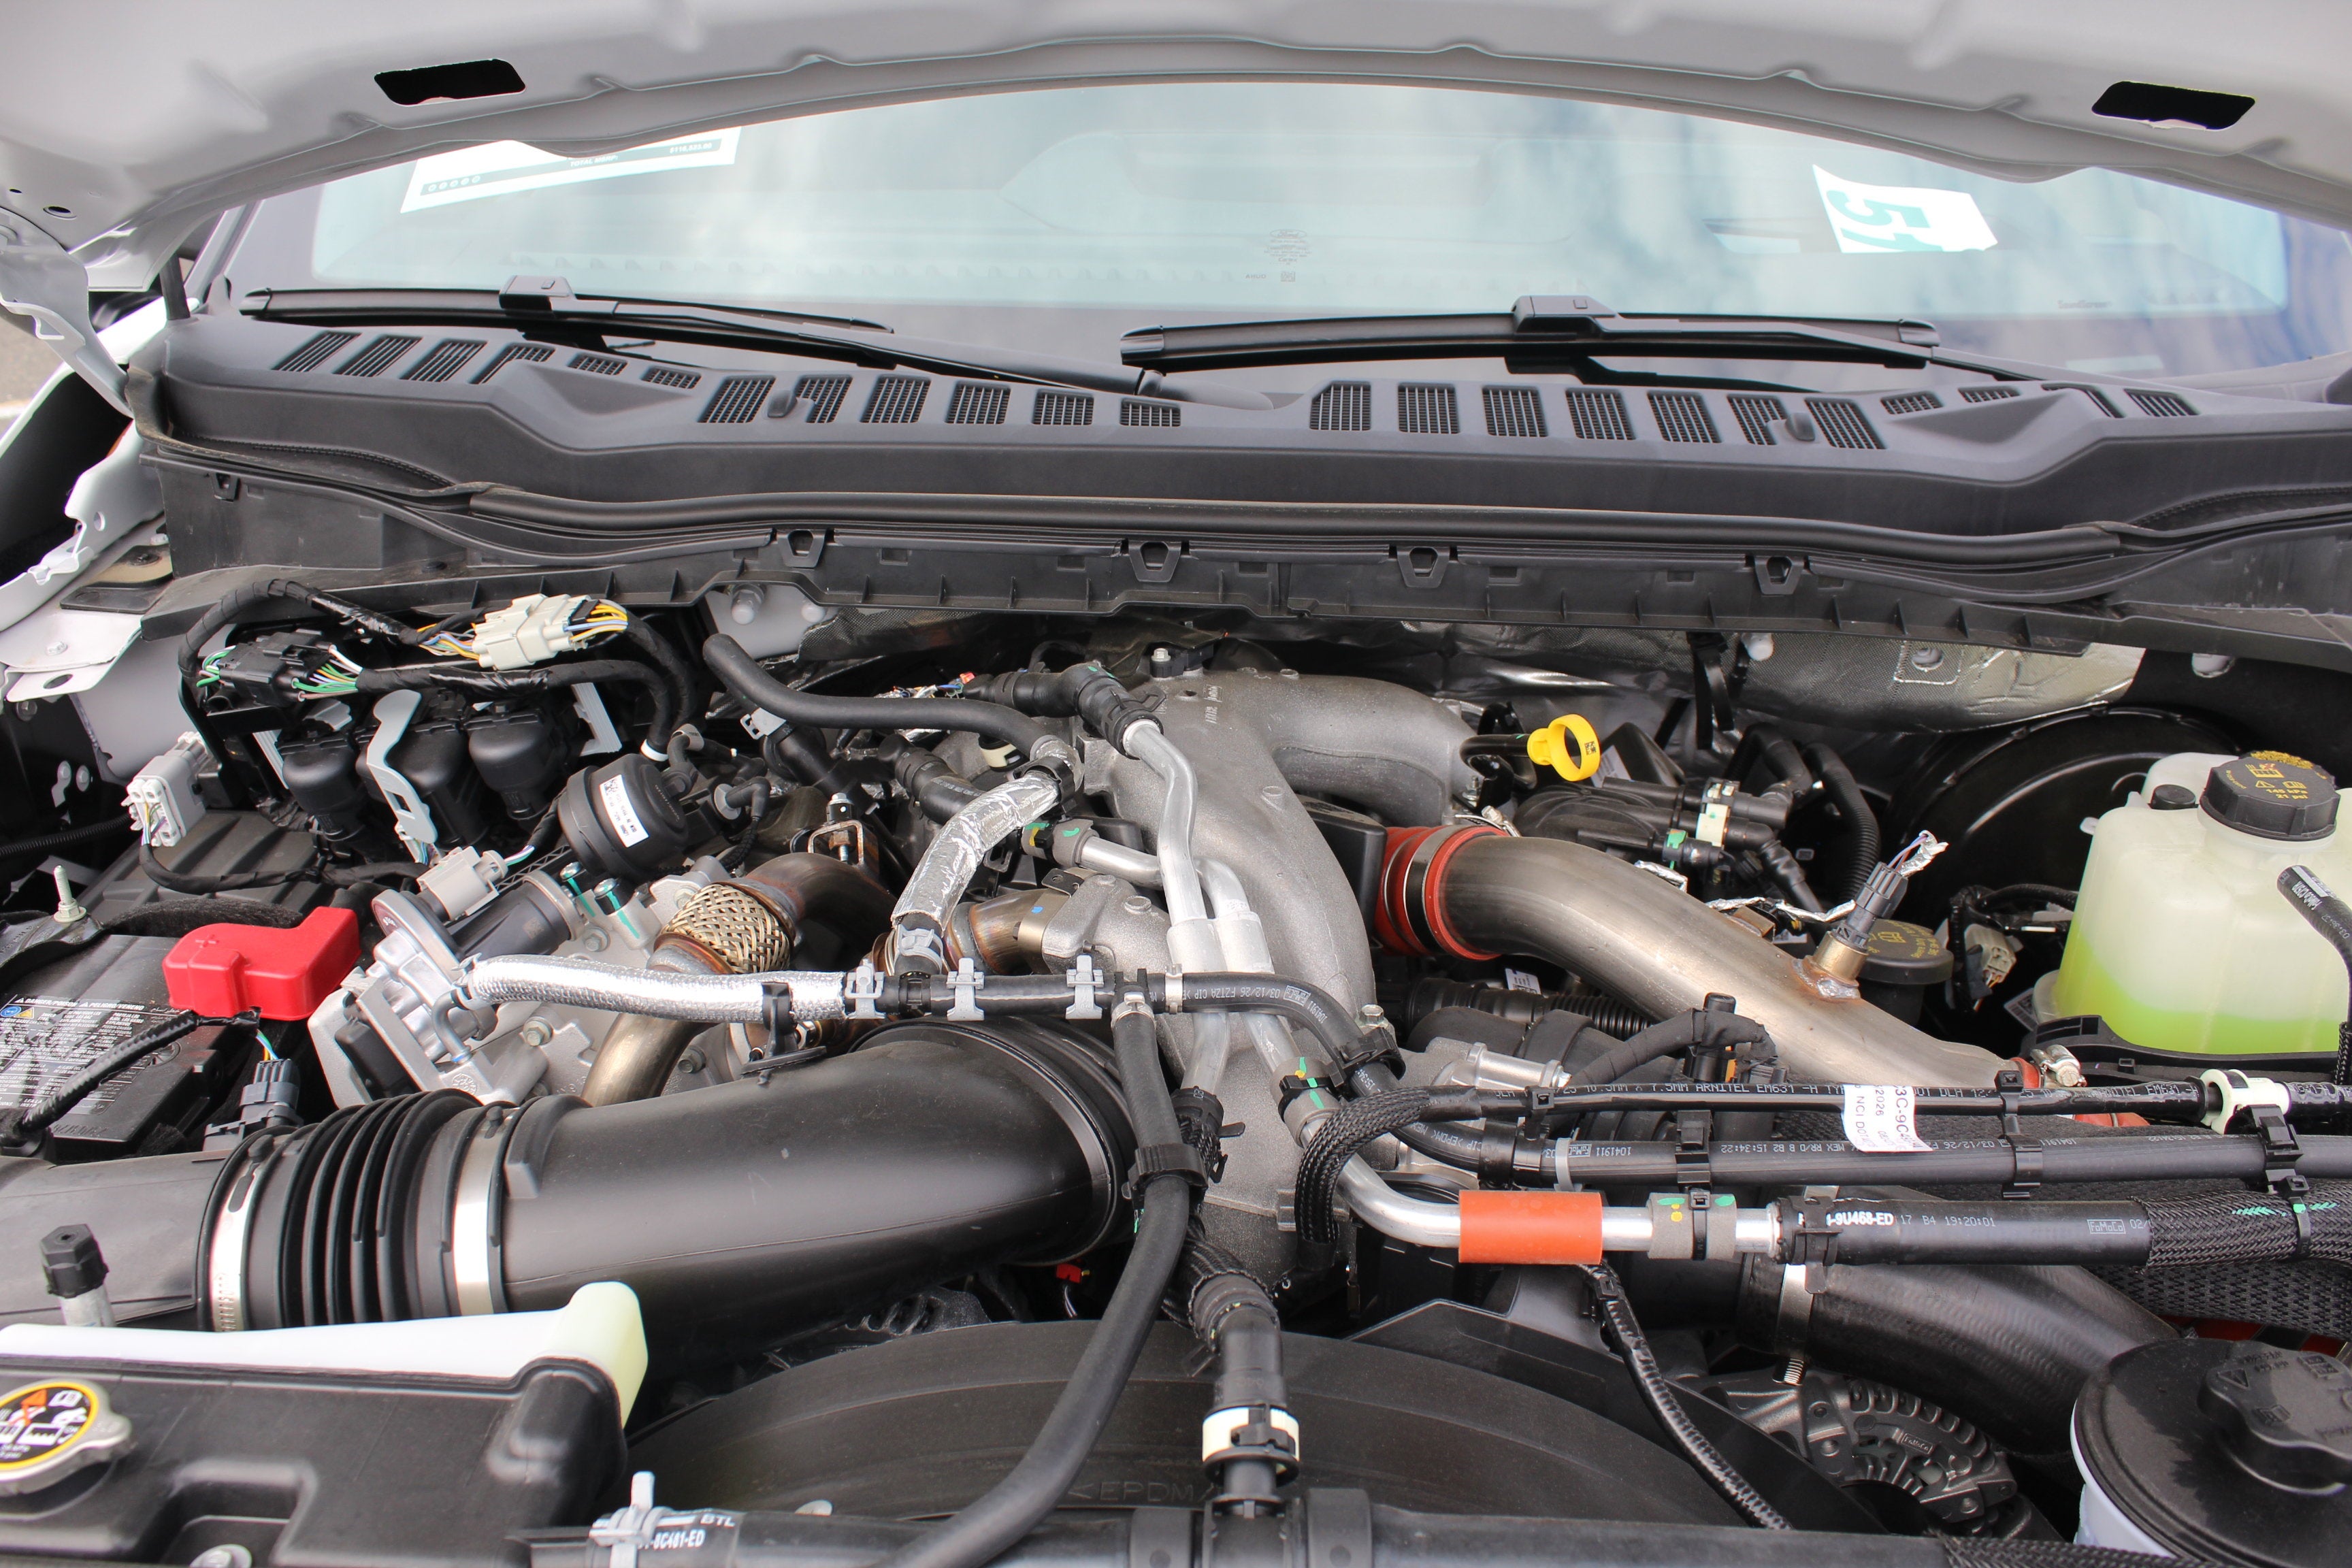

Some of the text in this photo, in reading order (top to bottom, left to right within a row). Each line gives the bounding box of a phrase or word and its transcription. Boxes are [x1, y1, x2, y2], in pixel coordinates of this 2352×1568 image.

[1194, 989, 1208, 1000] CIP
[1240, 987, 1280, 999] 03/12/26
[1650, 1083, 1689, 1093] 7.5MM
[1695, 1083, 1750, 1093] ARNITEL
[1757, 1083, 1795, 1094] EM631
[1939, 1088, 1963, 1098] DLA
[1720, 1143, 1846, 1154] MEX RR/D B B2 15:34:22
[1942, 1141, 1995, 1149] 03/12/26
[1568, 1146, 1590, 1156] FoMoC
[1596, 1146, 1632, 1157] 1041911
[1900, 1214, 1912, 1224] 17
[1923, 1215, 1936, 1224] B4
[1944, 1215, 1996, 1227] 19:20:01
[2089, 1221, 2124, 1232] FoMoCo
[700, 1513, 736, 1527] BTL
